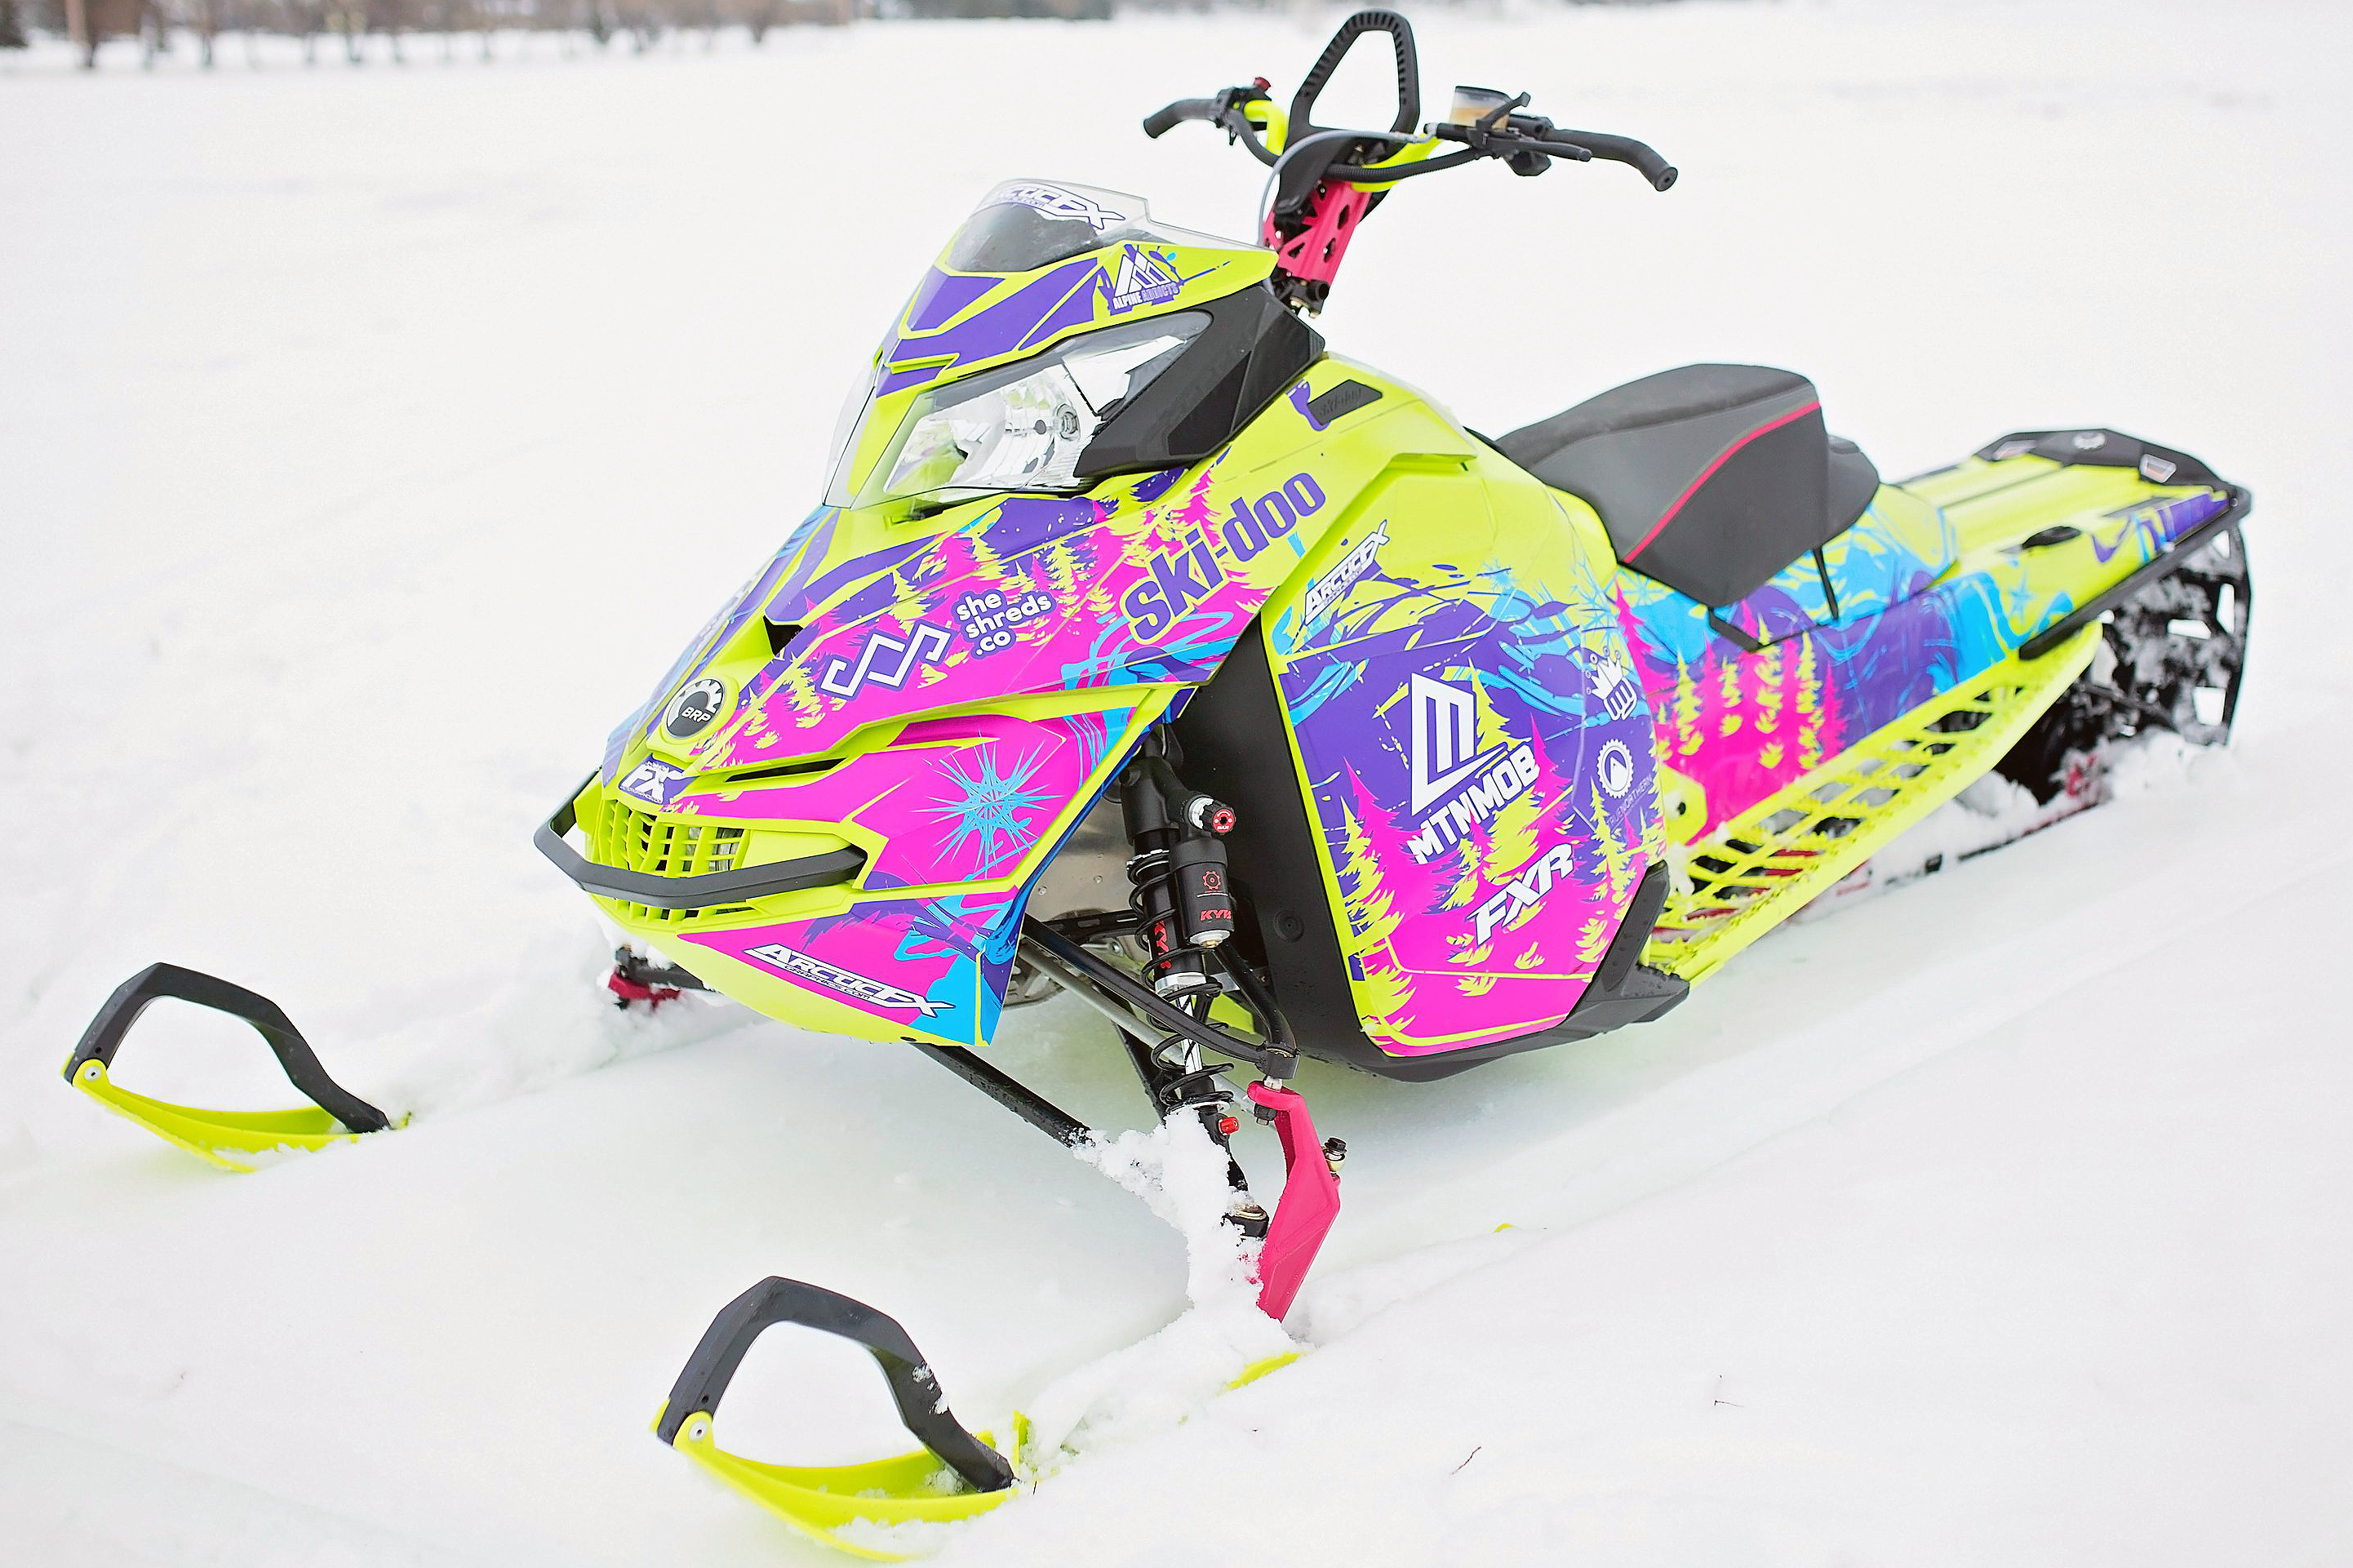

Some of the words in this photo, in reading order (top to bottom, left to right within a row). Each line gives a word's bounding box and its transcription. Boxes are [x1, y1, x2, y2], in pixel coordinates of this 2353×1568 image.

[1112, 291, 1143, 309] ALPINE
[1125, 472, 1326, 641] ski-doo
[956, 593, 1002, 621] she
[965, 594, 1052, 639] shreds
[975, 630, 1011, 655] .co
[681, 706, 712, 722] BRP
[619, 764, 684, 804] FX
[1406, 744, 1541, 865] MTNMOB
[1470, 843, 1574, 946] FXR
